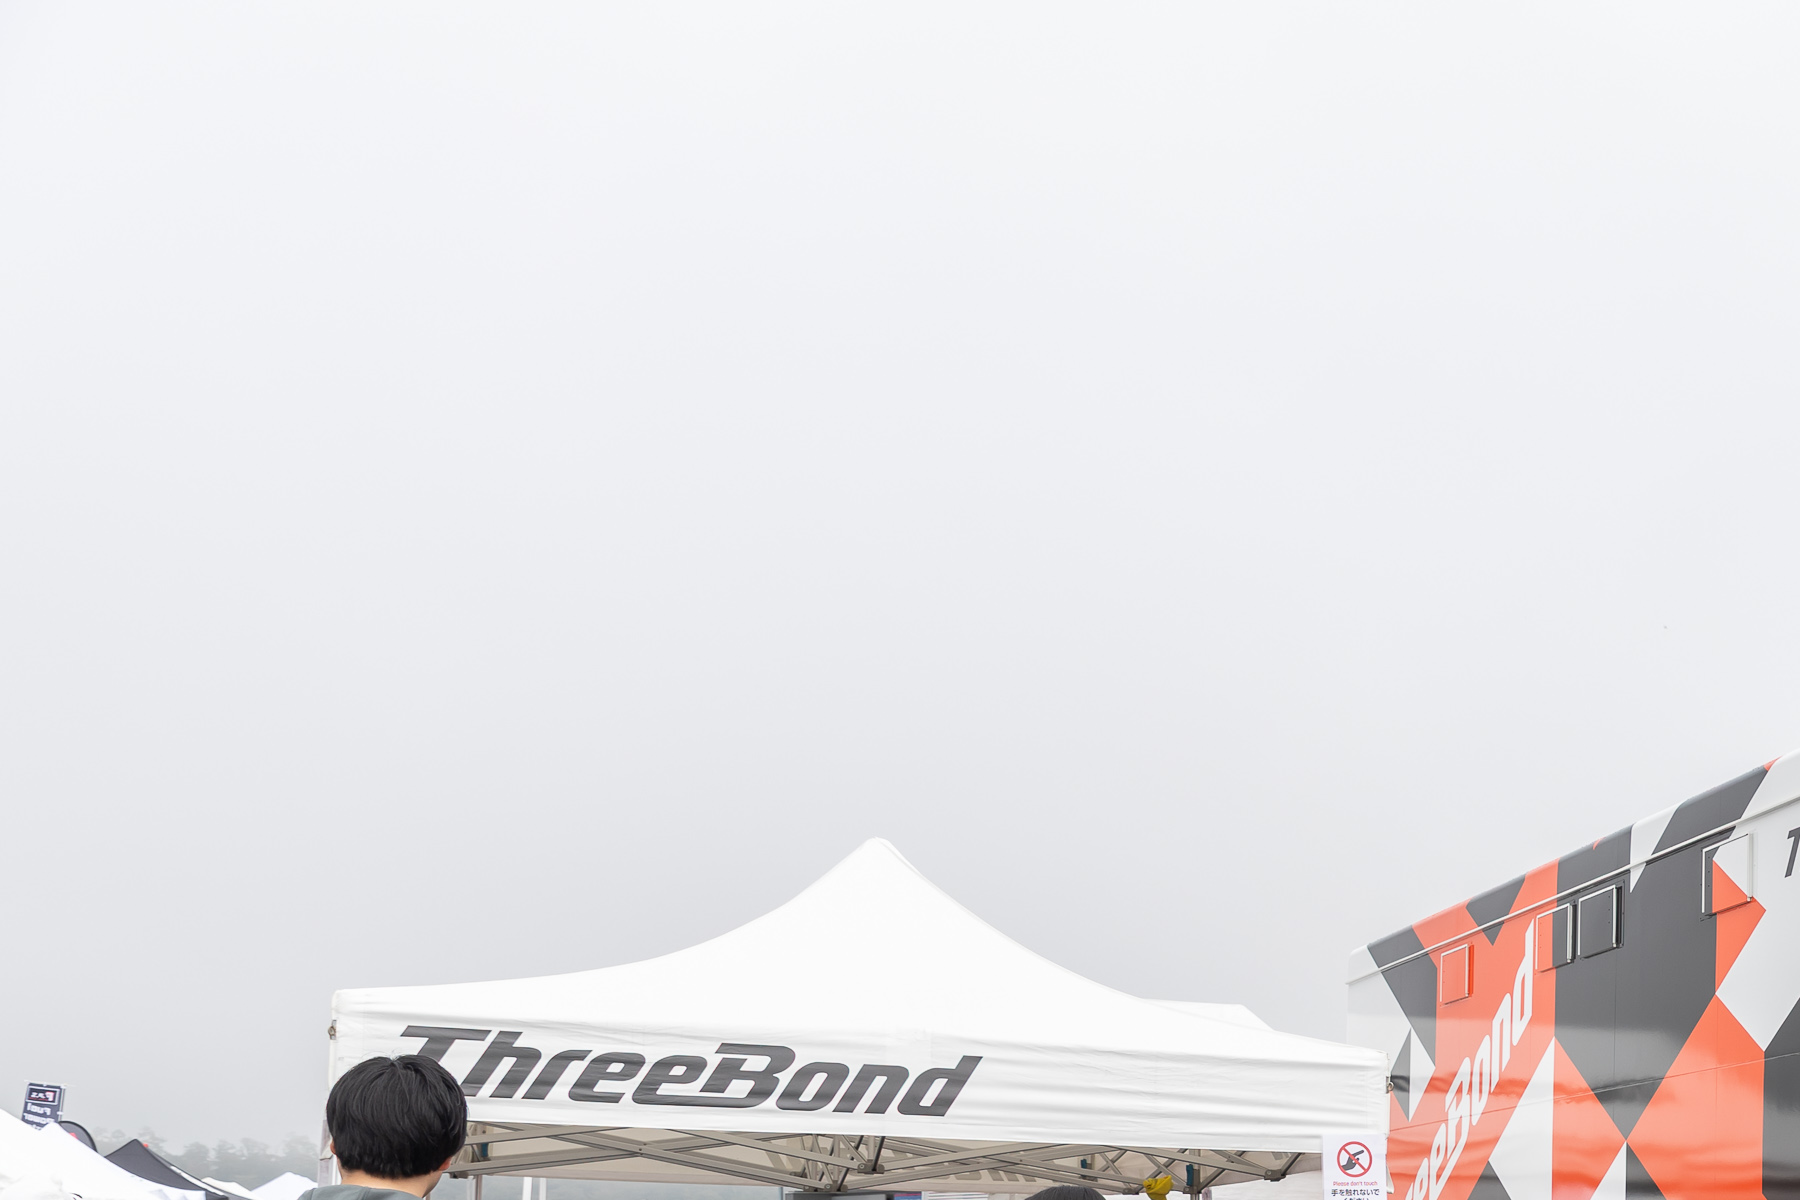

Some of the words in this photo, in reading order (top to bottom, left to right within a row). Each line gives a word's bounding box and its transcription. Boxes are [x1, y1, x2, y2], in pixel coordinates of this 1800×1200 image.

[400, 1024, 983, 1117] ThreeBond
[1331, 1188, 1380, 1197] 手を触れないで
